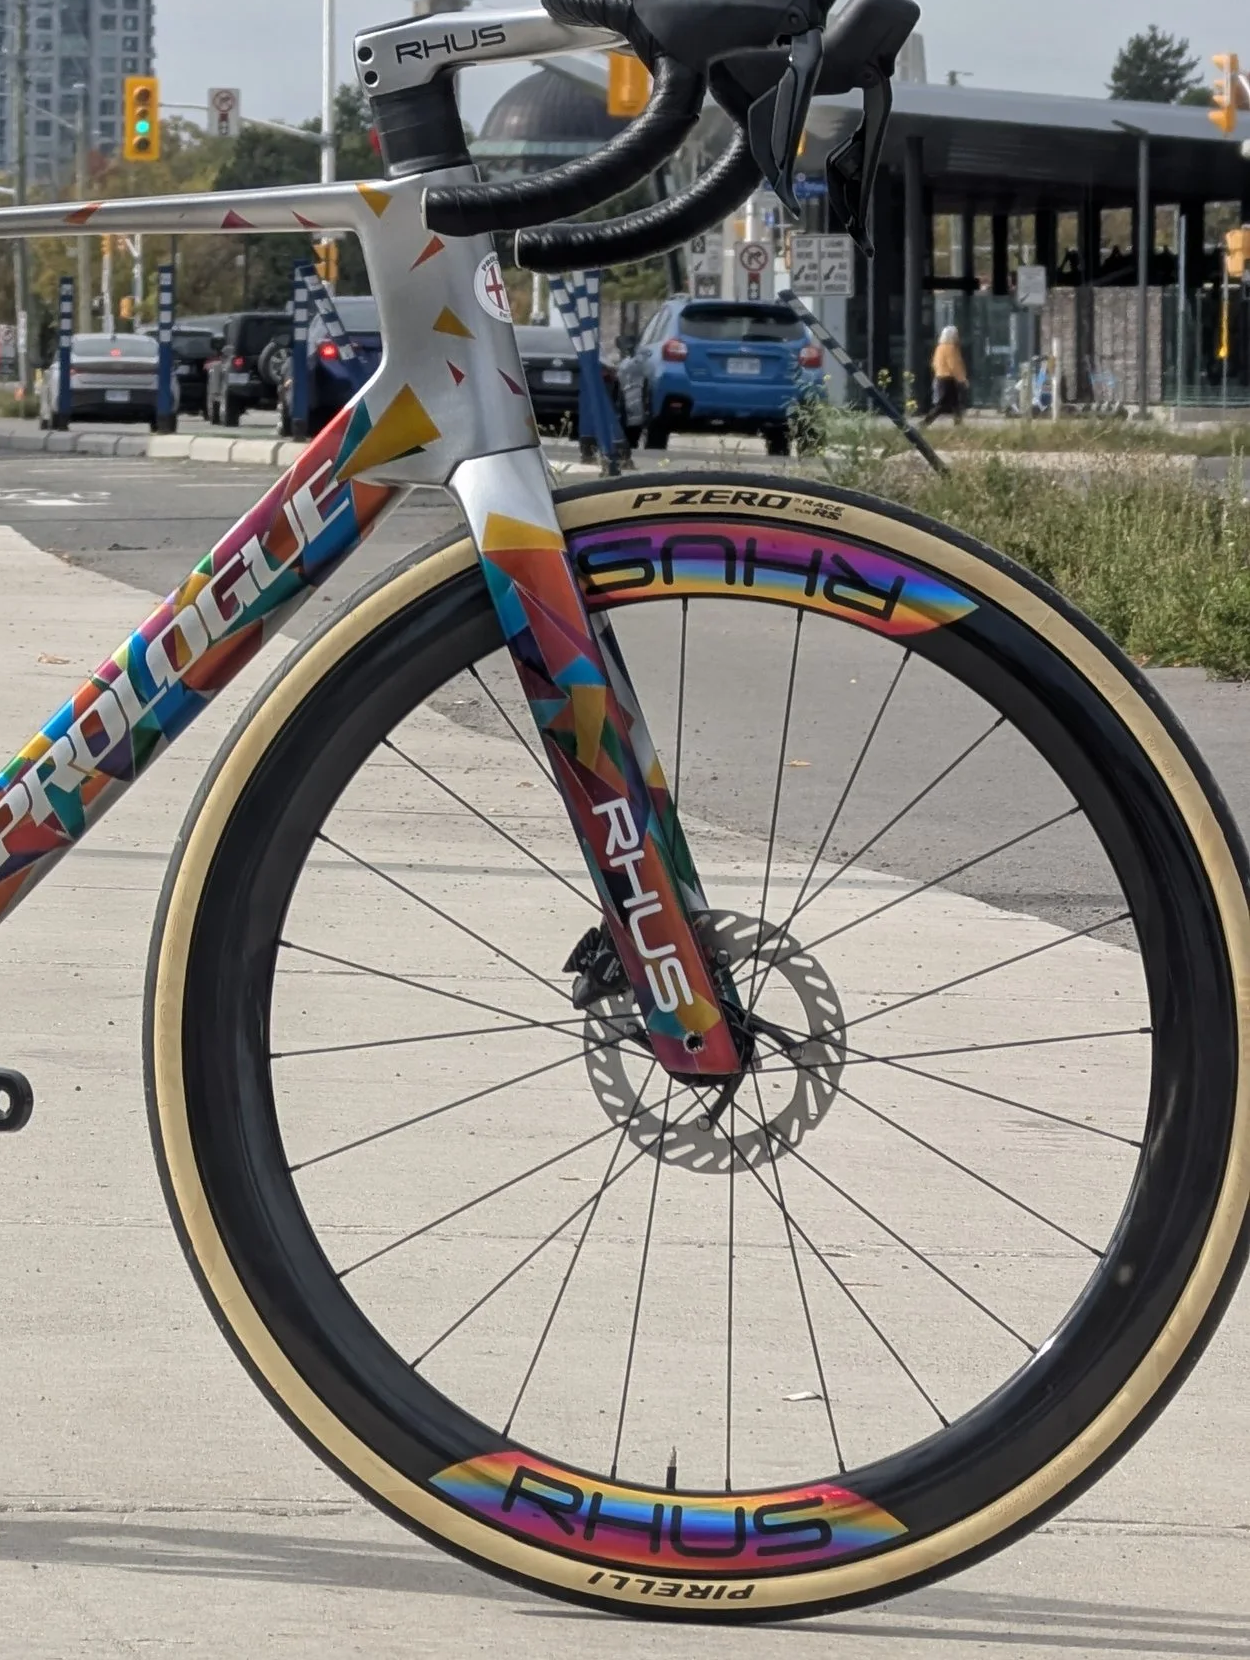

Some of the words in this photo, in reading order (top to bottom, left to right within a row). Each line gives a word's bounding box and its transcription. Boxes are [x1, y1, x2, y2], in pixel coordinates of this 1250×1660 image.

[395, 24, 506, 64] RHUS
[631, 492, 663, 510] P
[668, 489, 793, 510] ZERO
[576, 534, 906, 621] RHUS
[591, 796, 694, 1014] RHUS
[501, 1465, 833, 1558] RHUS
[587, 1571, 755, 1601] PIRELLI
